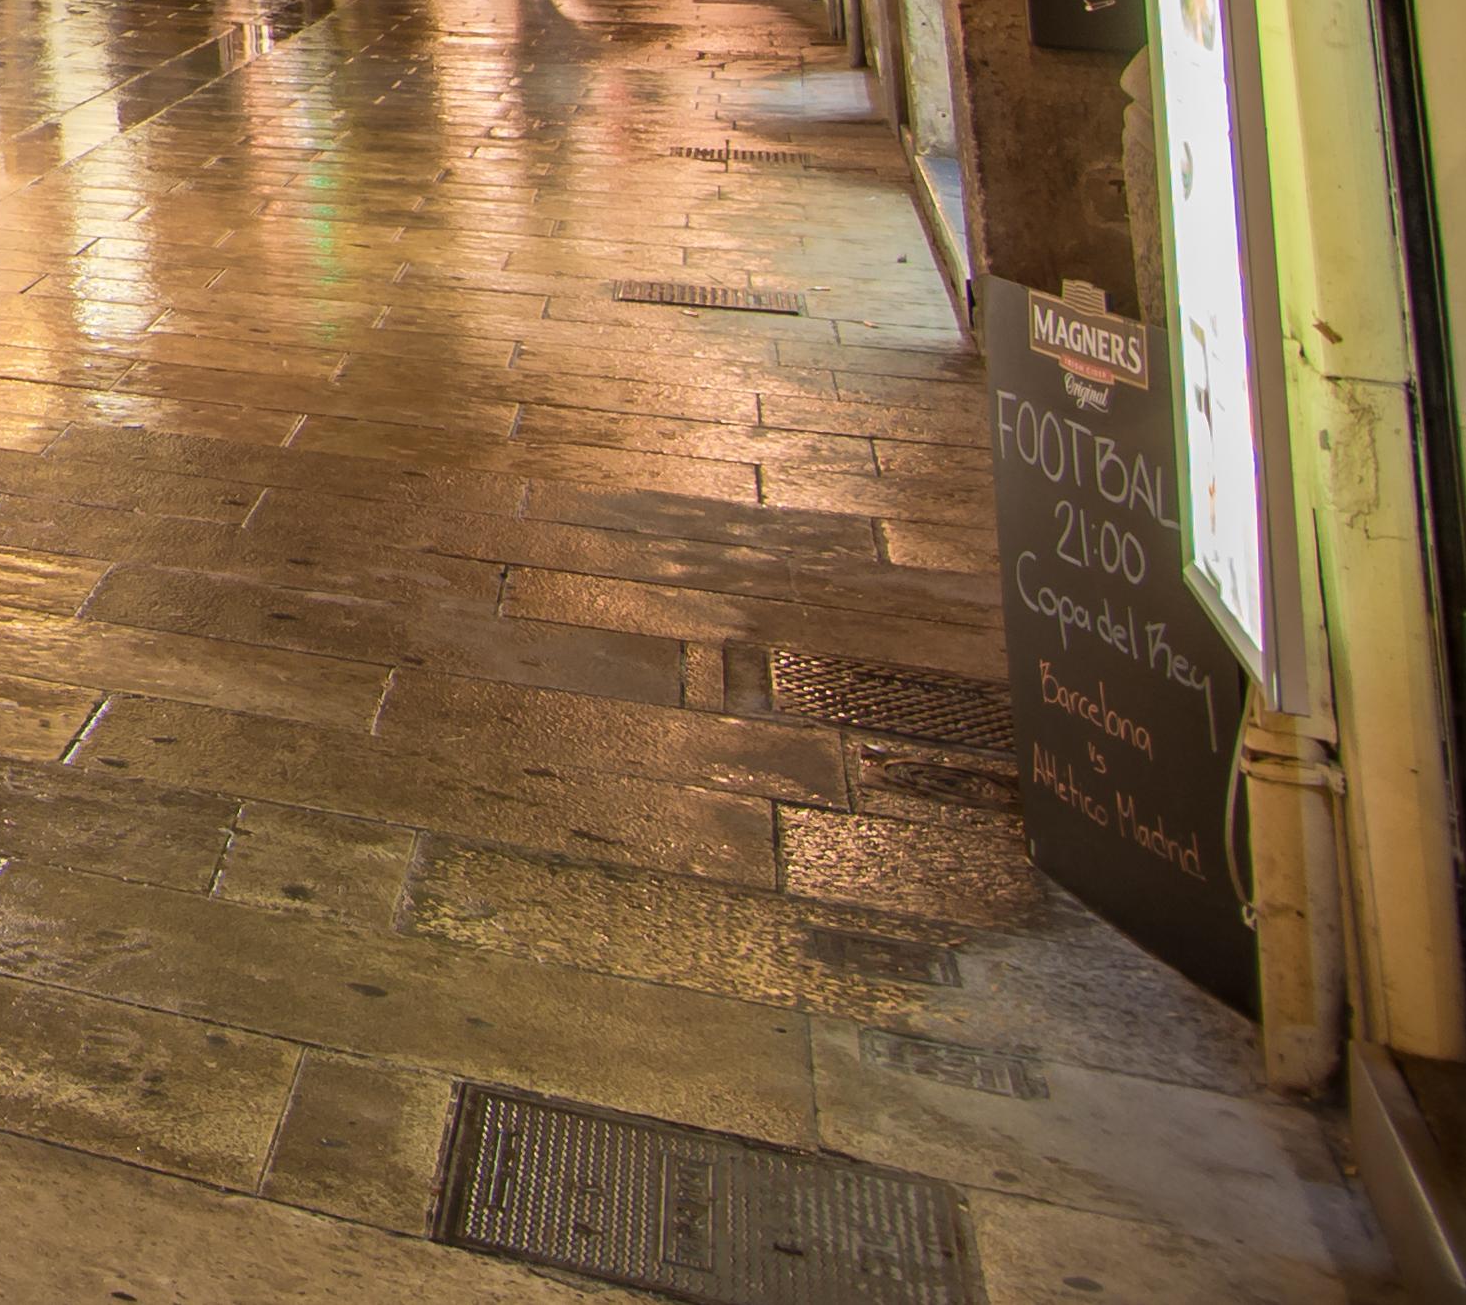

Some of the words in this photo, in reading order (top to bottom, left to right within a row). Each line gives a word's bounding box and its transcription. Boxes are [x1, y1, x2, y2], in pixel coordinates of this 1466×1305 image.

[1033, 304, 1142, 374] MAGNERS
[1064, 372, 1109, 413] Original
[1054, 500, 1145, 585] 21:00
[1016, 551, 1092, 651] Copa
[1097, 598, 1138, 660] del
[1145, 621, 1217, 753] Rey
[1039, 659, 1153, 760] Barcelona
[1116, 790, 1206, 881] Madrid
